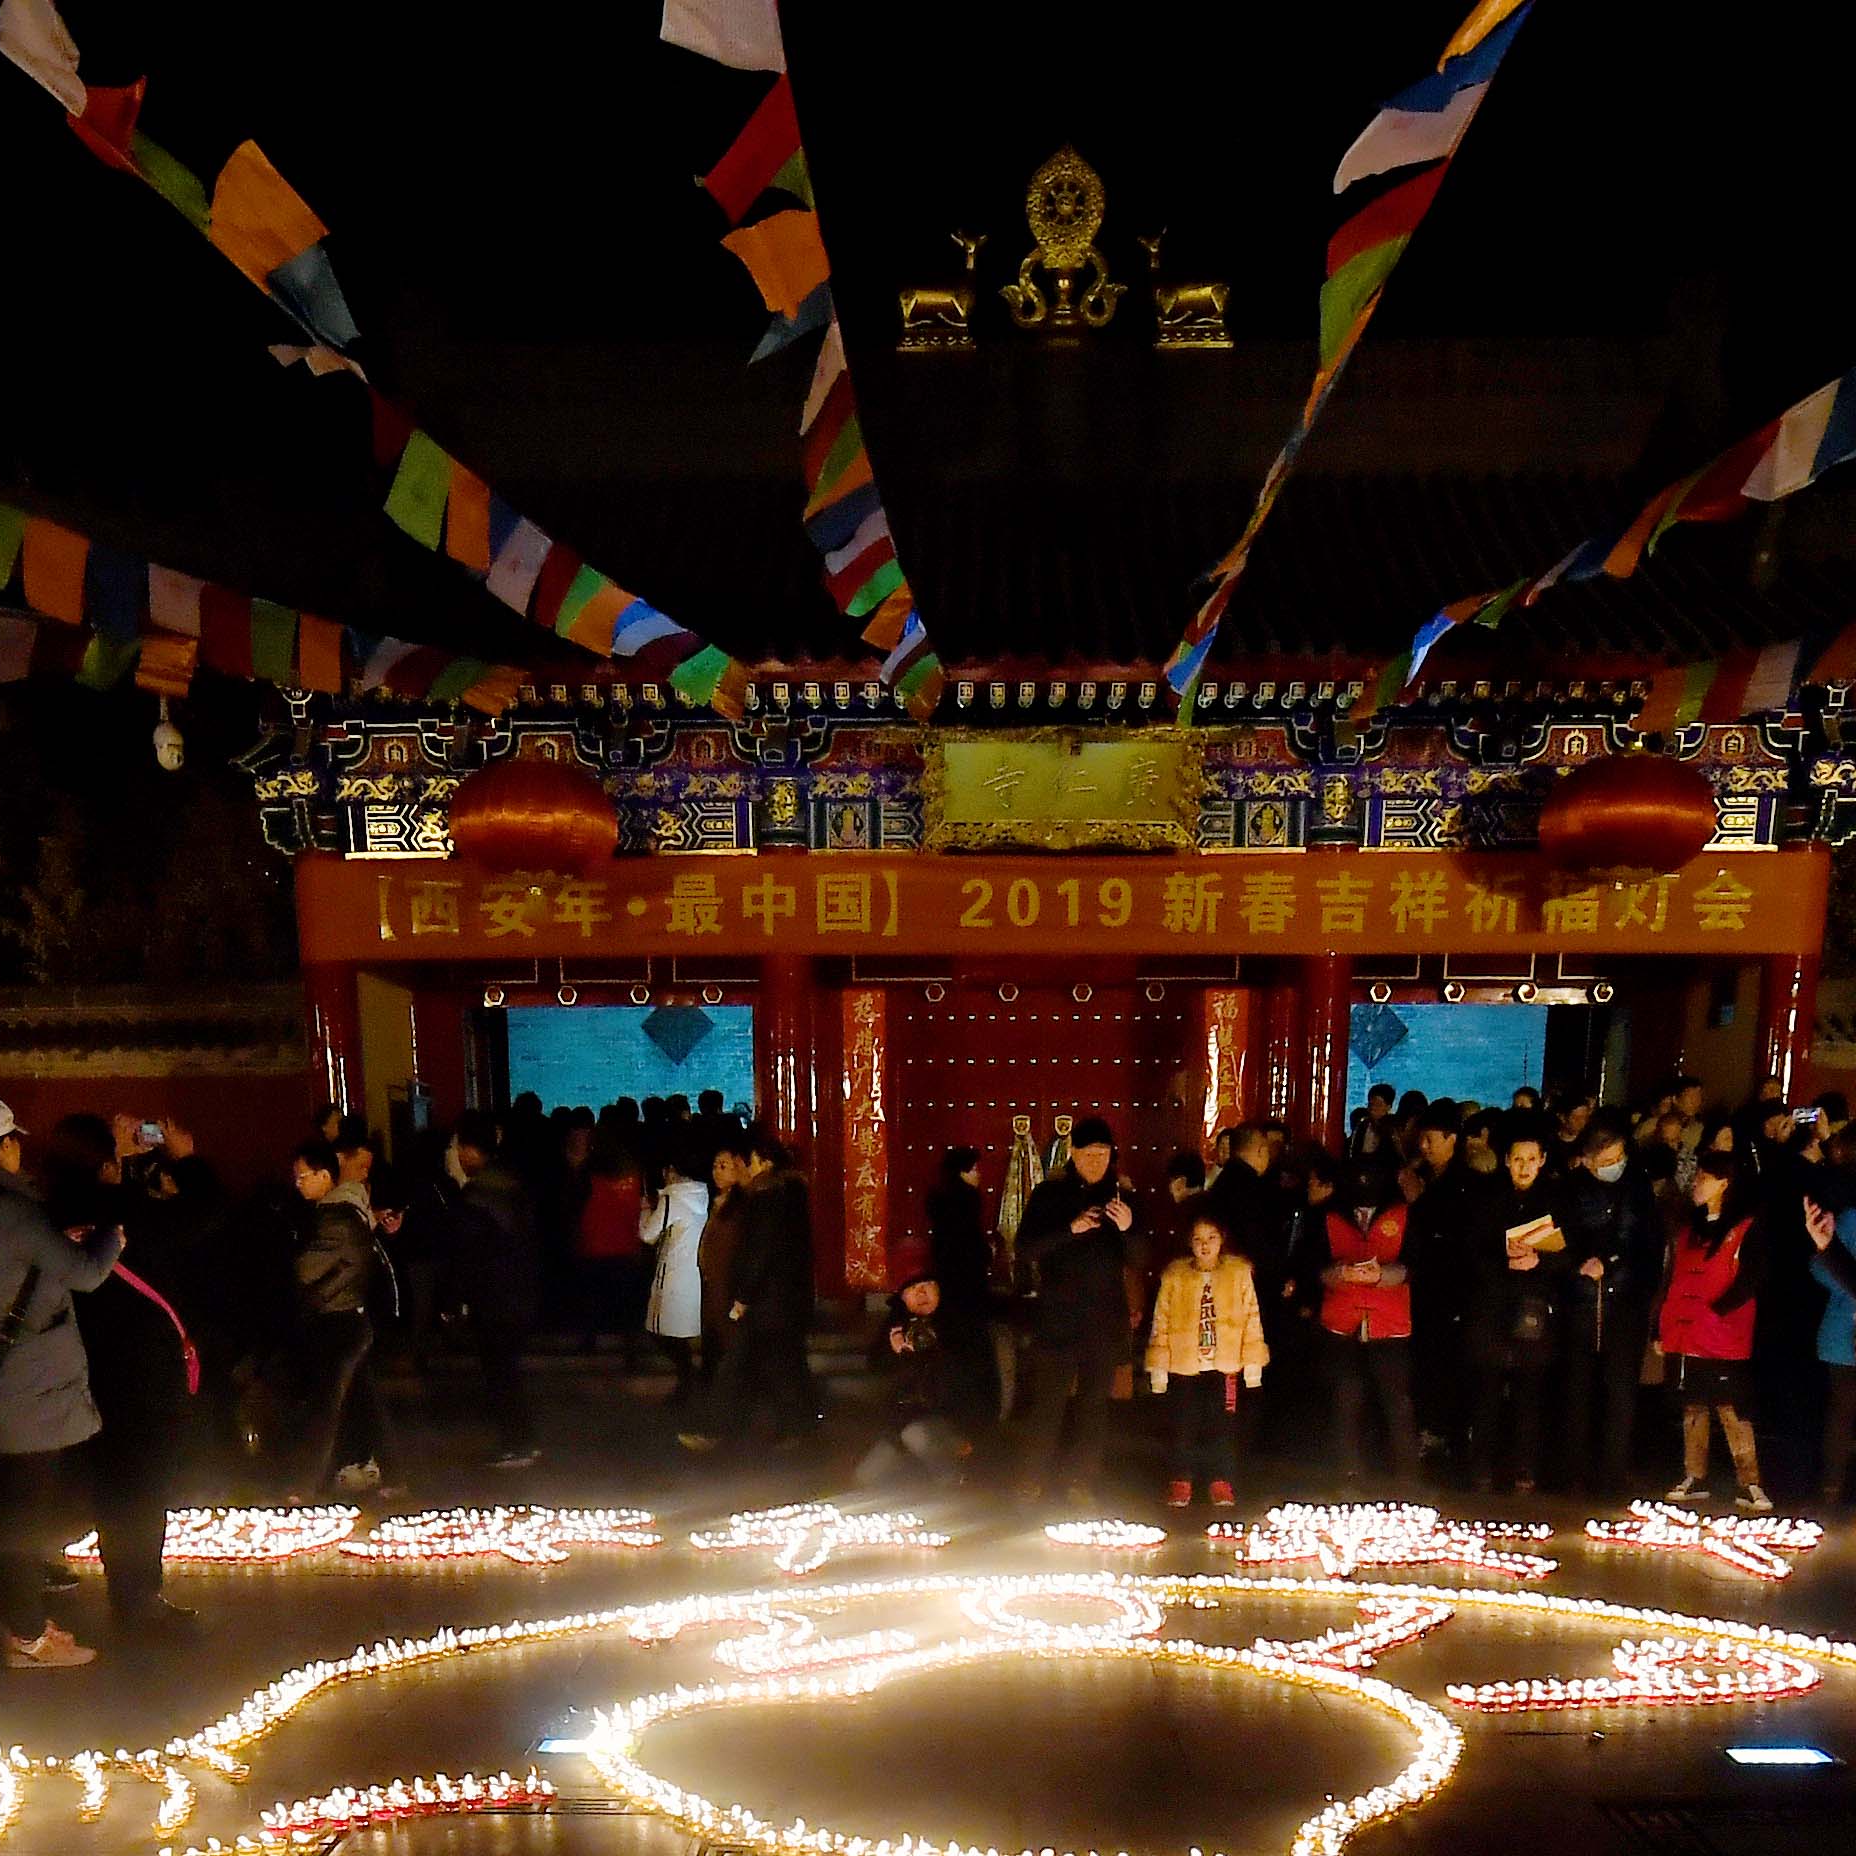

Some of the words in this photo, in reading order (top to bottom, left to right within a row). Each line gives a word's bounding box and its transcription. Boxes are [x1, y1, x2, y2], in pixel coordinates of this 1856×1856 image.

[959, 878, 1133, 929] 2019
[1159, 869, 1754, 936] 新春吉祥祈福灯会
